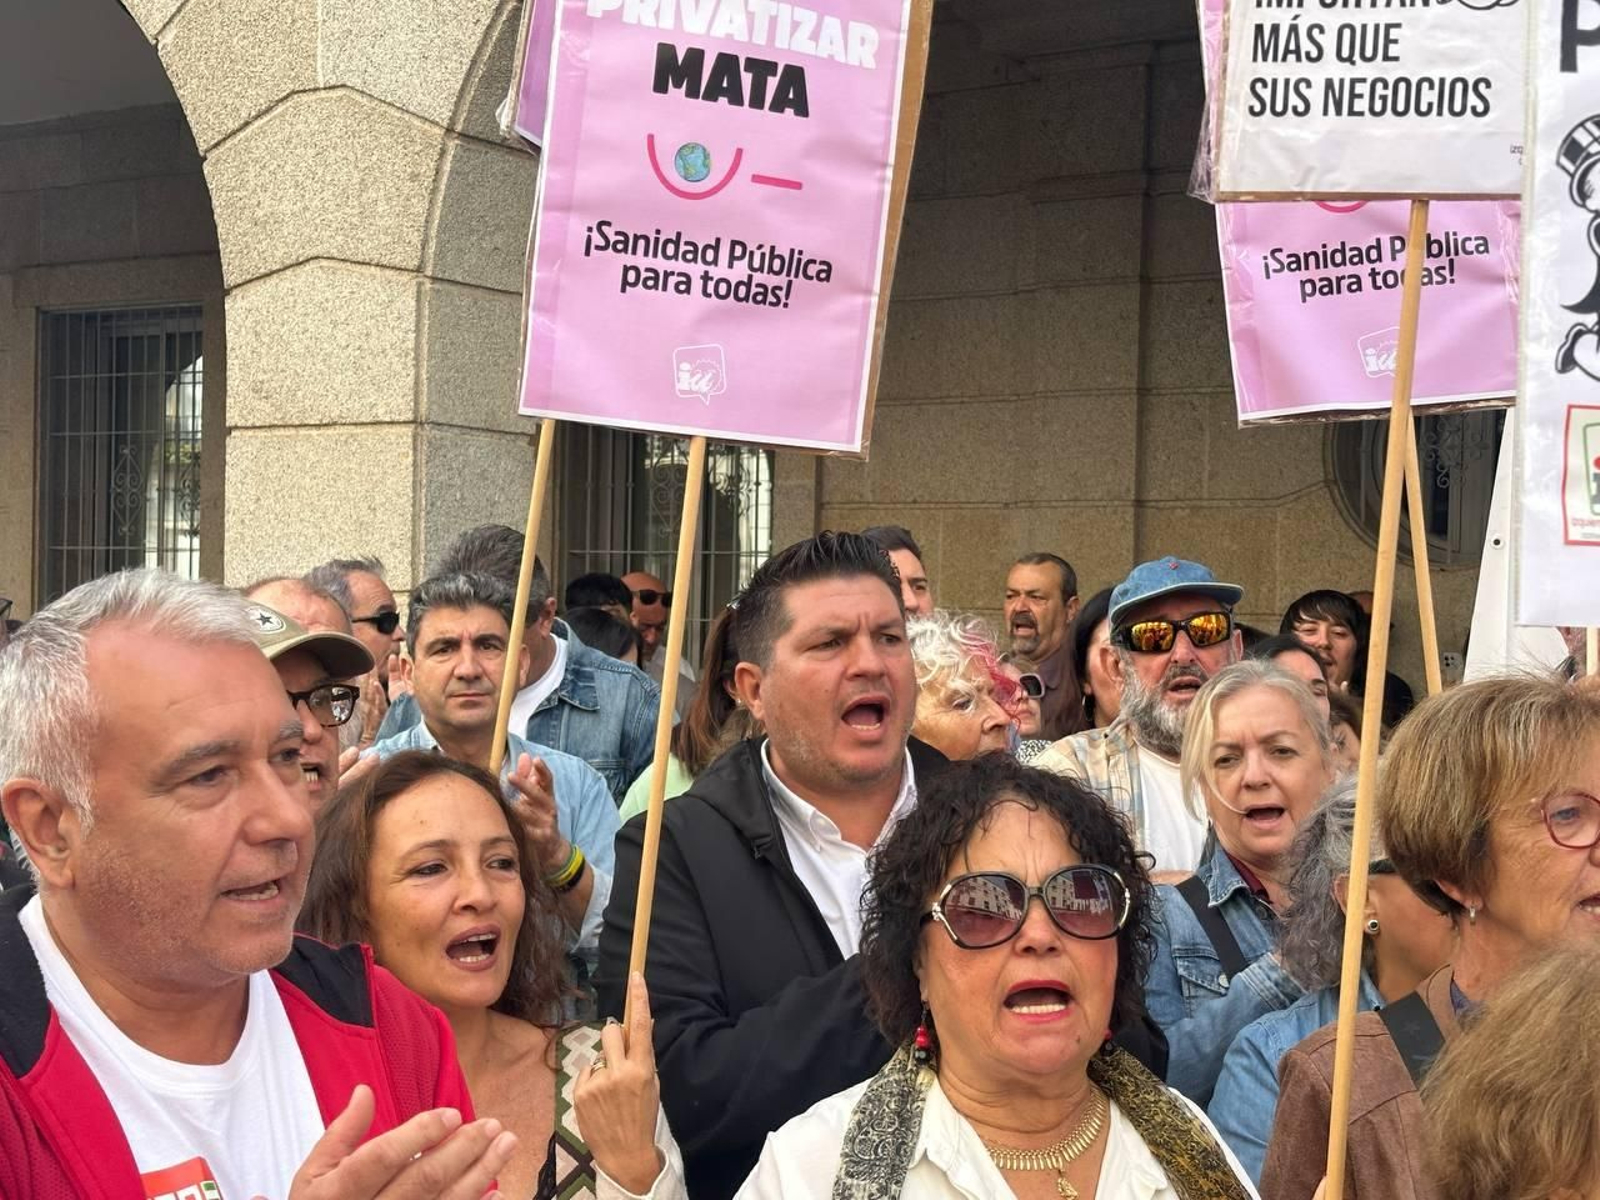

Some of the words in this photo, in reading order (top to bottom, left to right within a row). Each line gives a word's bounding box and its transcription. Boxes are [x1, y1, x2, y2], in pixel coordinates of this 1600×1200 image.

[1252, 14, 1325, 63] MÁS
[1335, 22, 1402, 65] QUE
[652, 42, 810, 118] MATA
[1248, 77, 1312, 117] SUS
[1322, 76, 1492, 117] NEGOCIOS
[584, 219, 721, 266] ¡Sanidad
[727, 239, 833, 283] Pública
[1262, 237, 1382, 279] ¡Sanidad
[1390, 231, 1490, 262] Pblica
[620, 263, 692, 294] para
[700, 269, 793, 308] todas!
[1299, 273, 1363, 303] para
[1367, 257, 1456, 291] toas!
